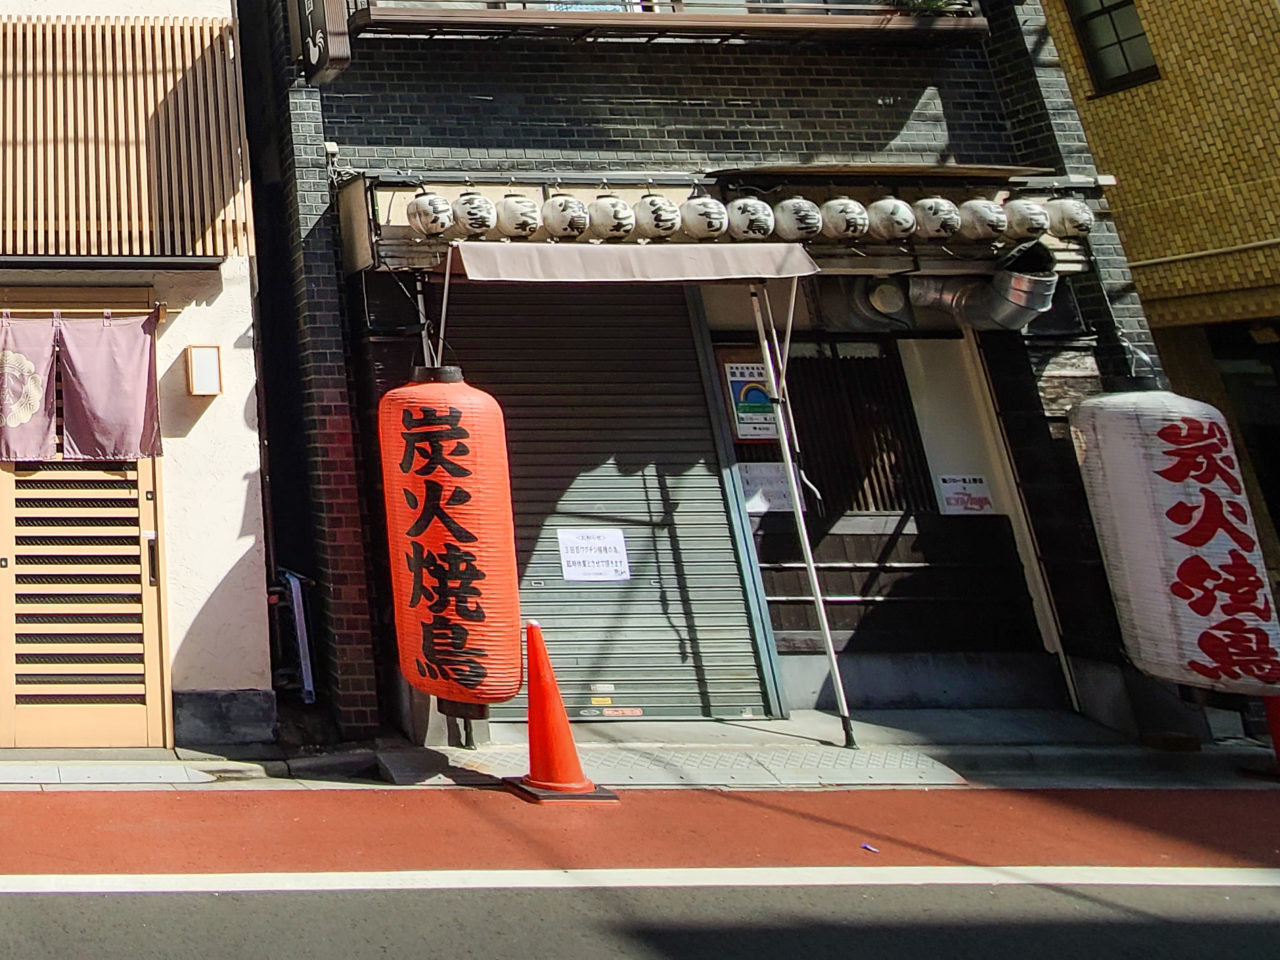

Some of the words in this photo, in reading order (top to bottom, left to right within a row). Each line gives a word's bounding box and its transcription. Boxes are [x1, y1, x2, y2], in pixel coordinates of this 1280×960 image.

[398, 406, 489, 690] 炭火焼鳥
[1153, 416, 1280, 685] 炭火焼鳥
